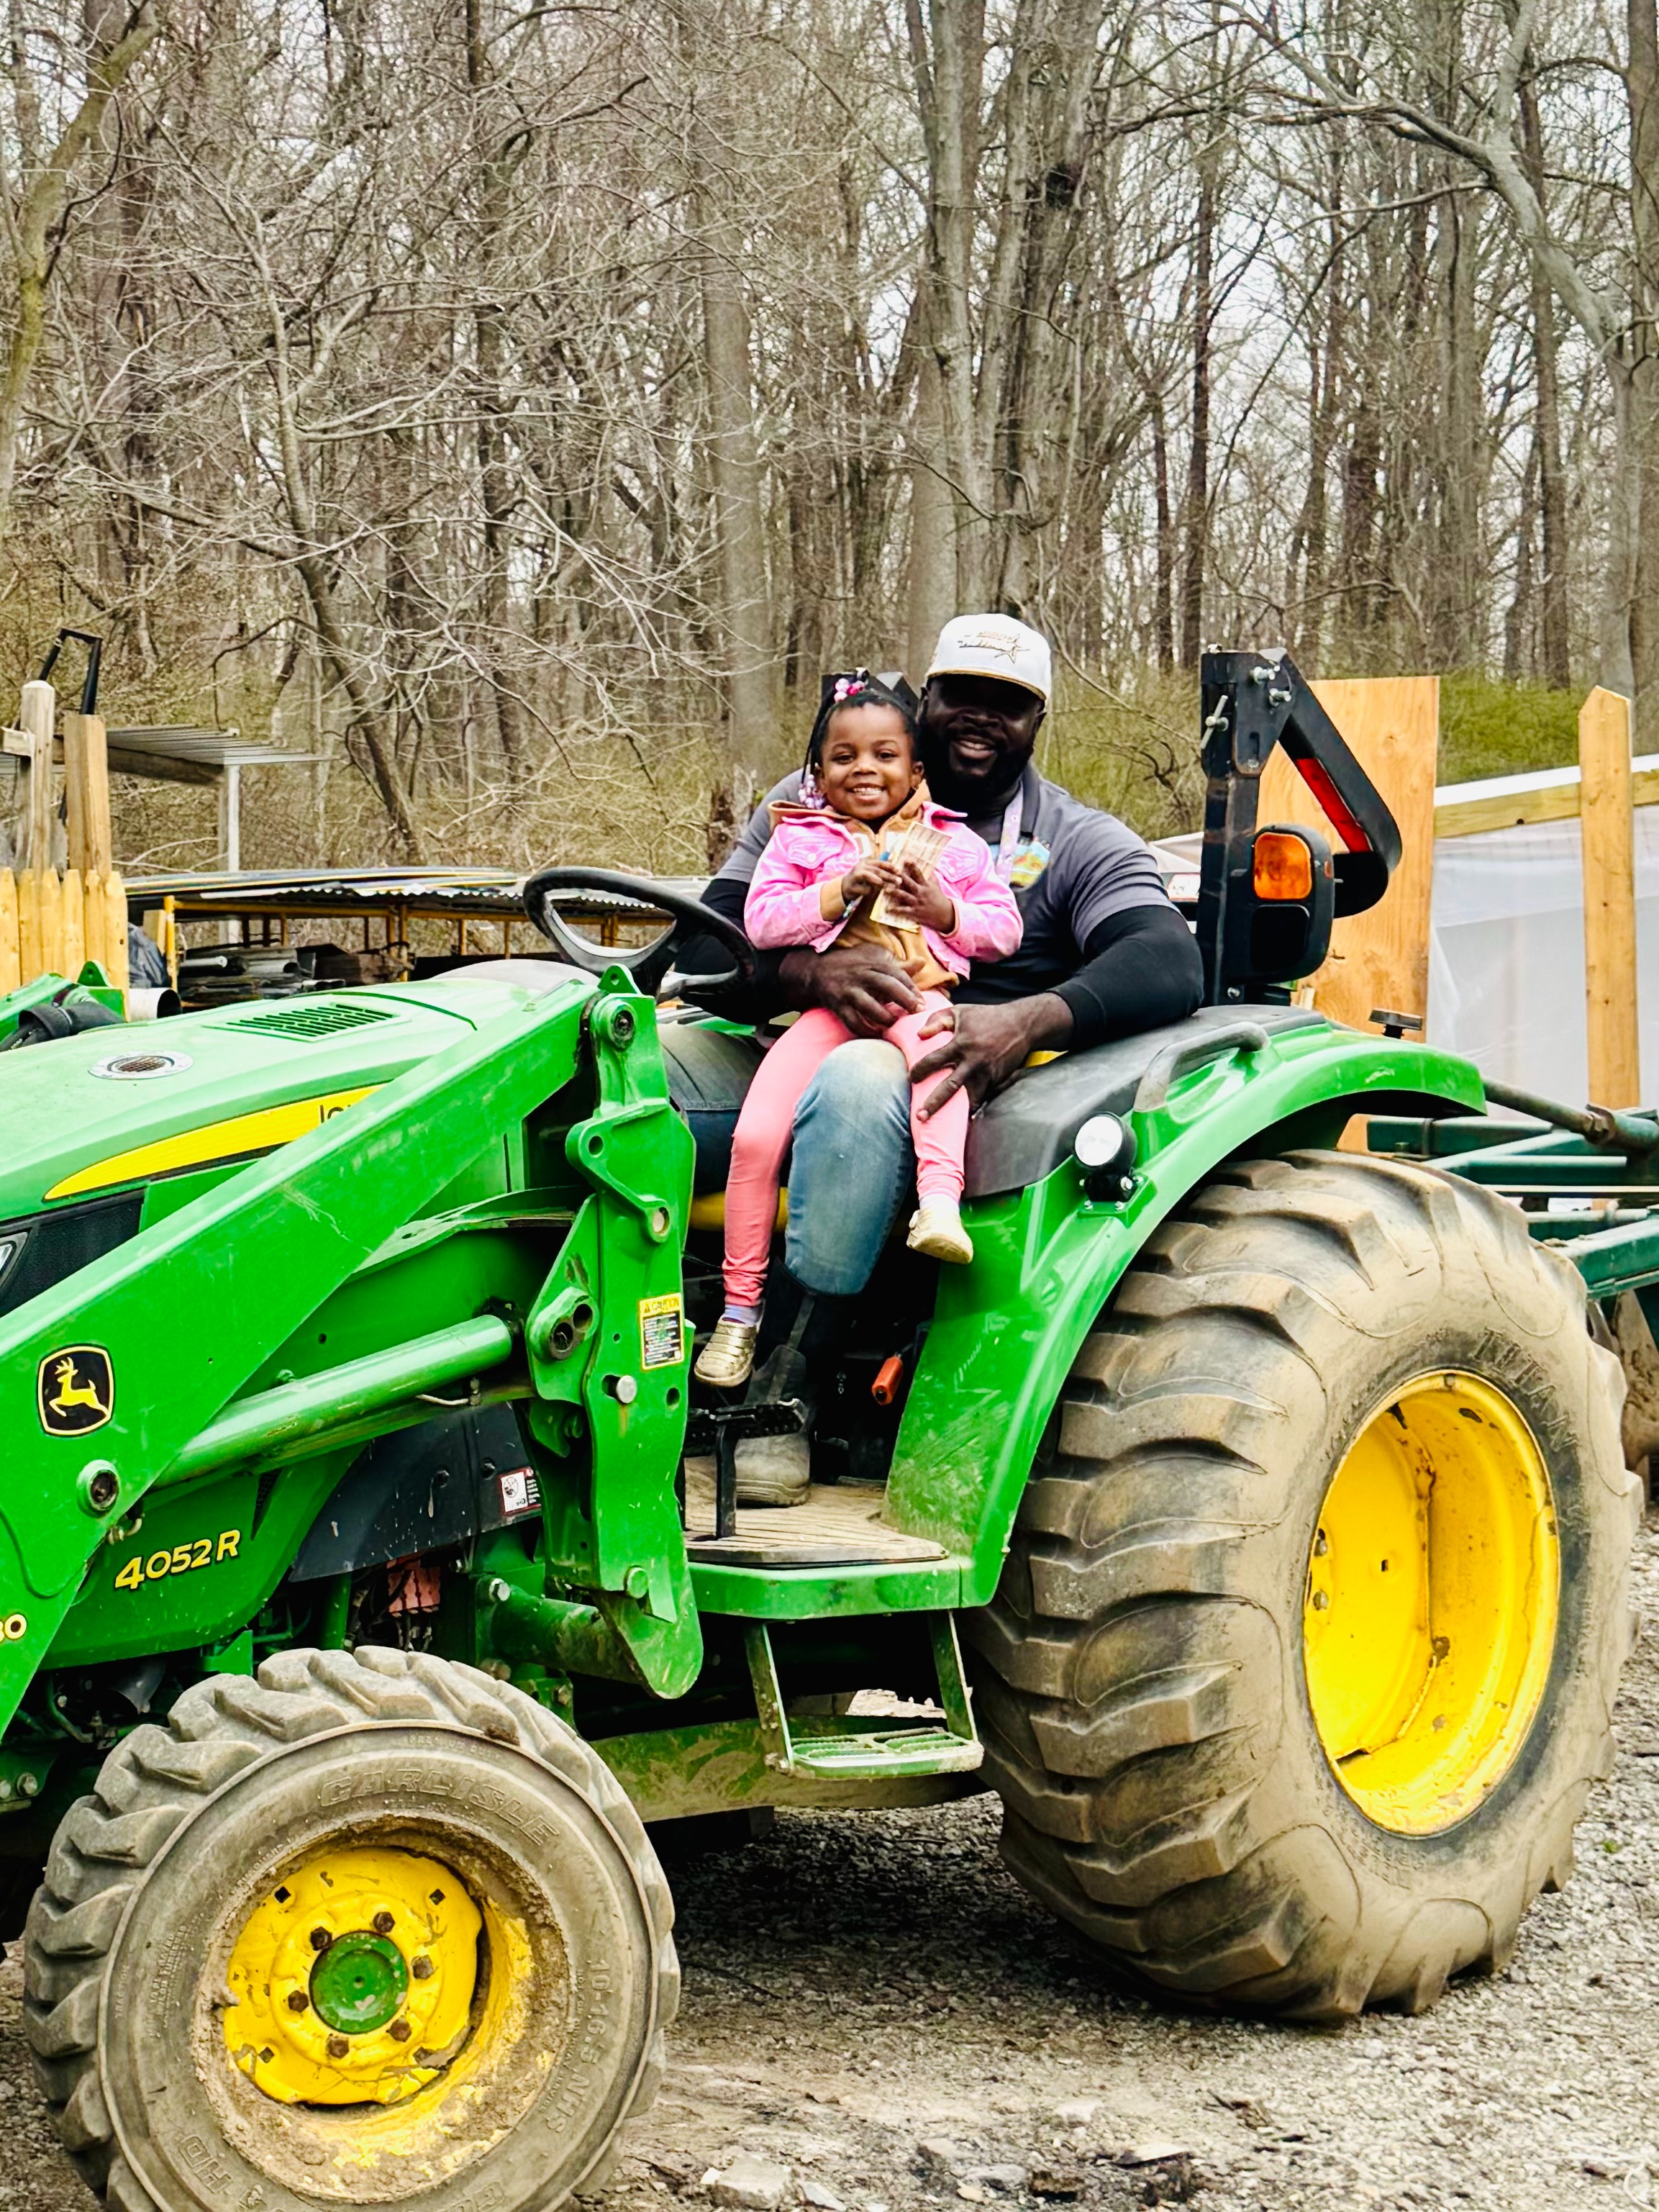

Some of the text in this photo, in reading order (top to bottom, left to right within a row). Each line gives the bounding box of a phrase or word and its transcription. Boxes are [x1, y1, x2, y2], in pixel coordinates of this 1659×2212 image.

[1473, 1326, 1581, 1452] TITAN
[114, 1529, 241, 1590] 4052R
[0, 1613, 27, 1644] 0
[321, 1767, 559, 1846] CARLISLE
[545, 2071, 590, 2133] NHS
